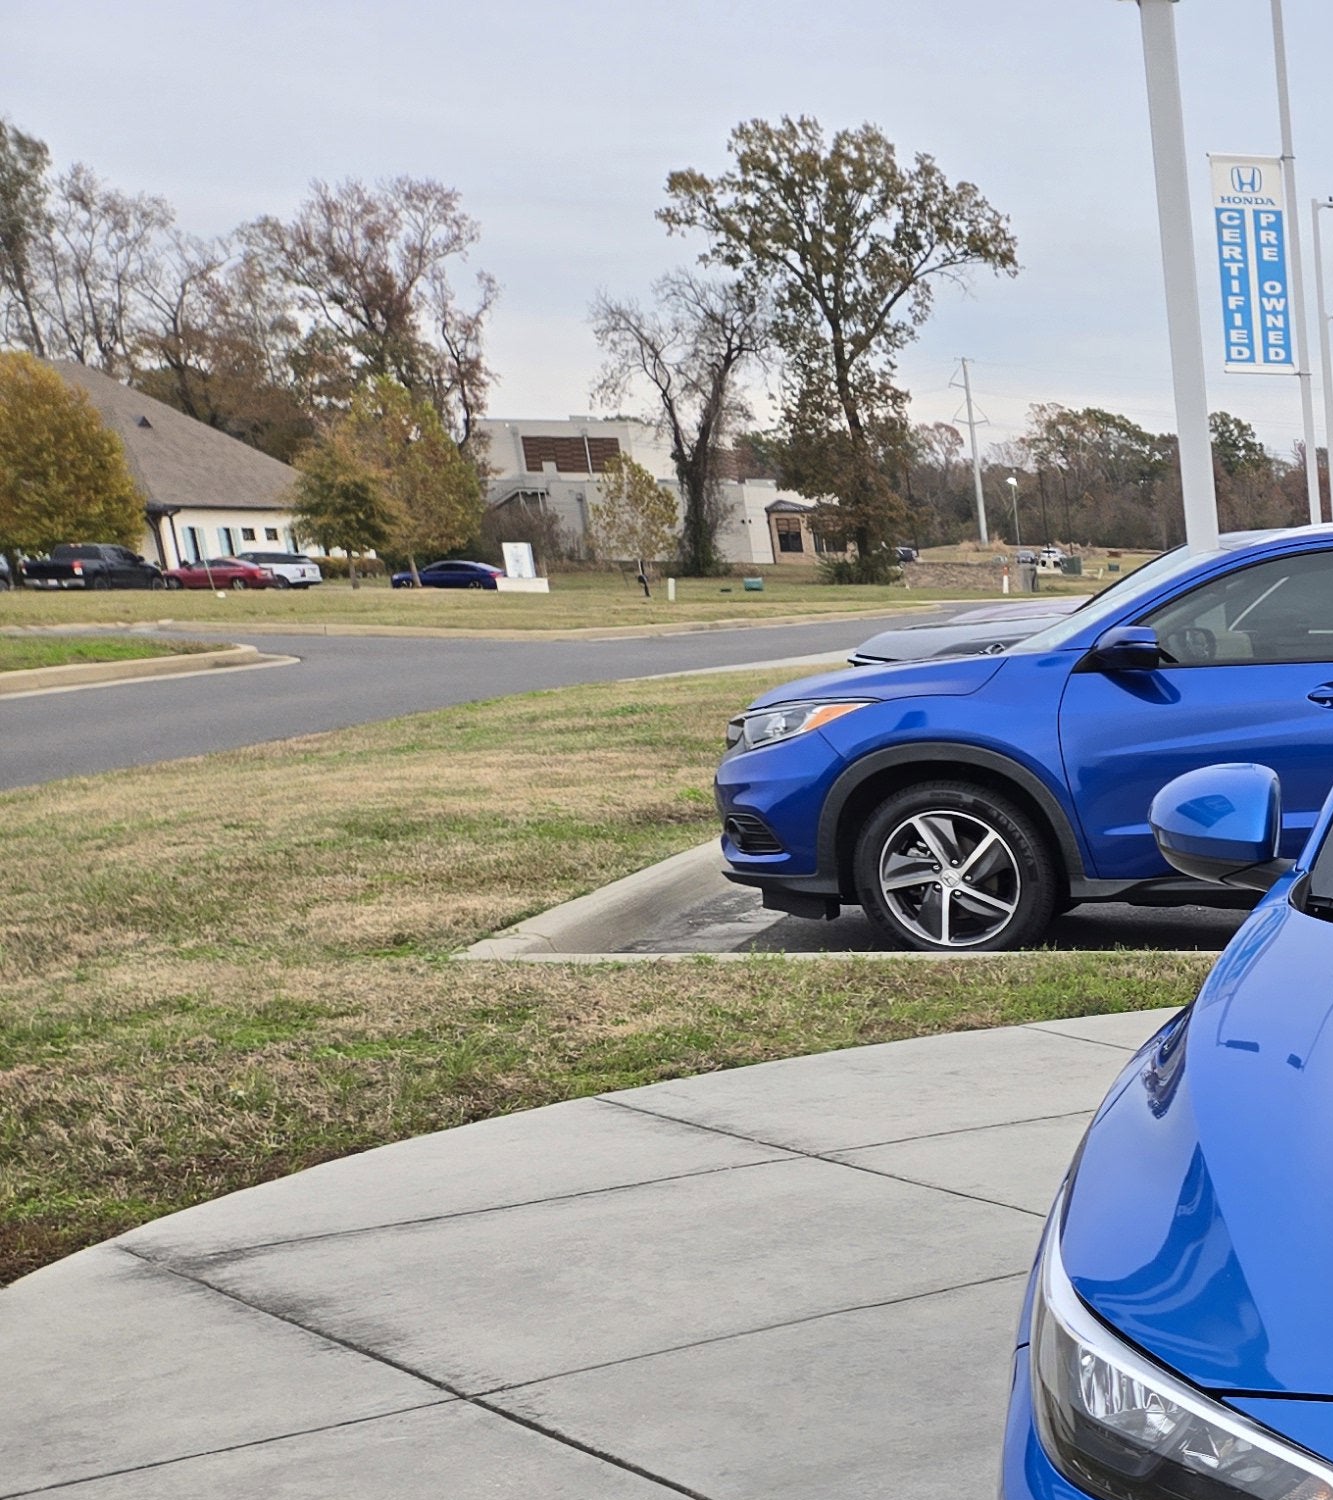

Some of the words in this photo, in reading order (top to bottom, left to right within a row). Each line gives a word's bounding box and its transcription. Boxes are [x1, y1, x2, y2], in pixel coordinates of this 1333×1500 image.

[1220, 195, 1276, 206] HONDA
[1259, 212, 1279, 262] PRE
[1219, 211, 1251, 361] CERTIFIED
[1261, 280, 1287, 361] OWNED
